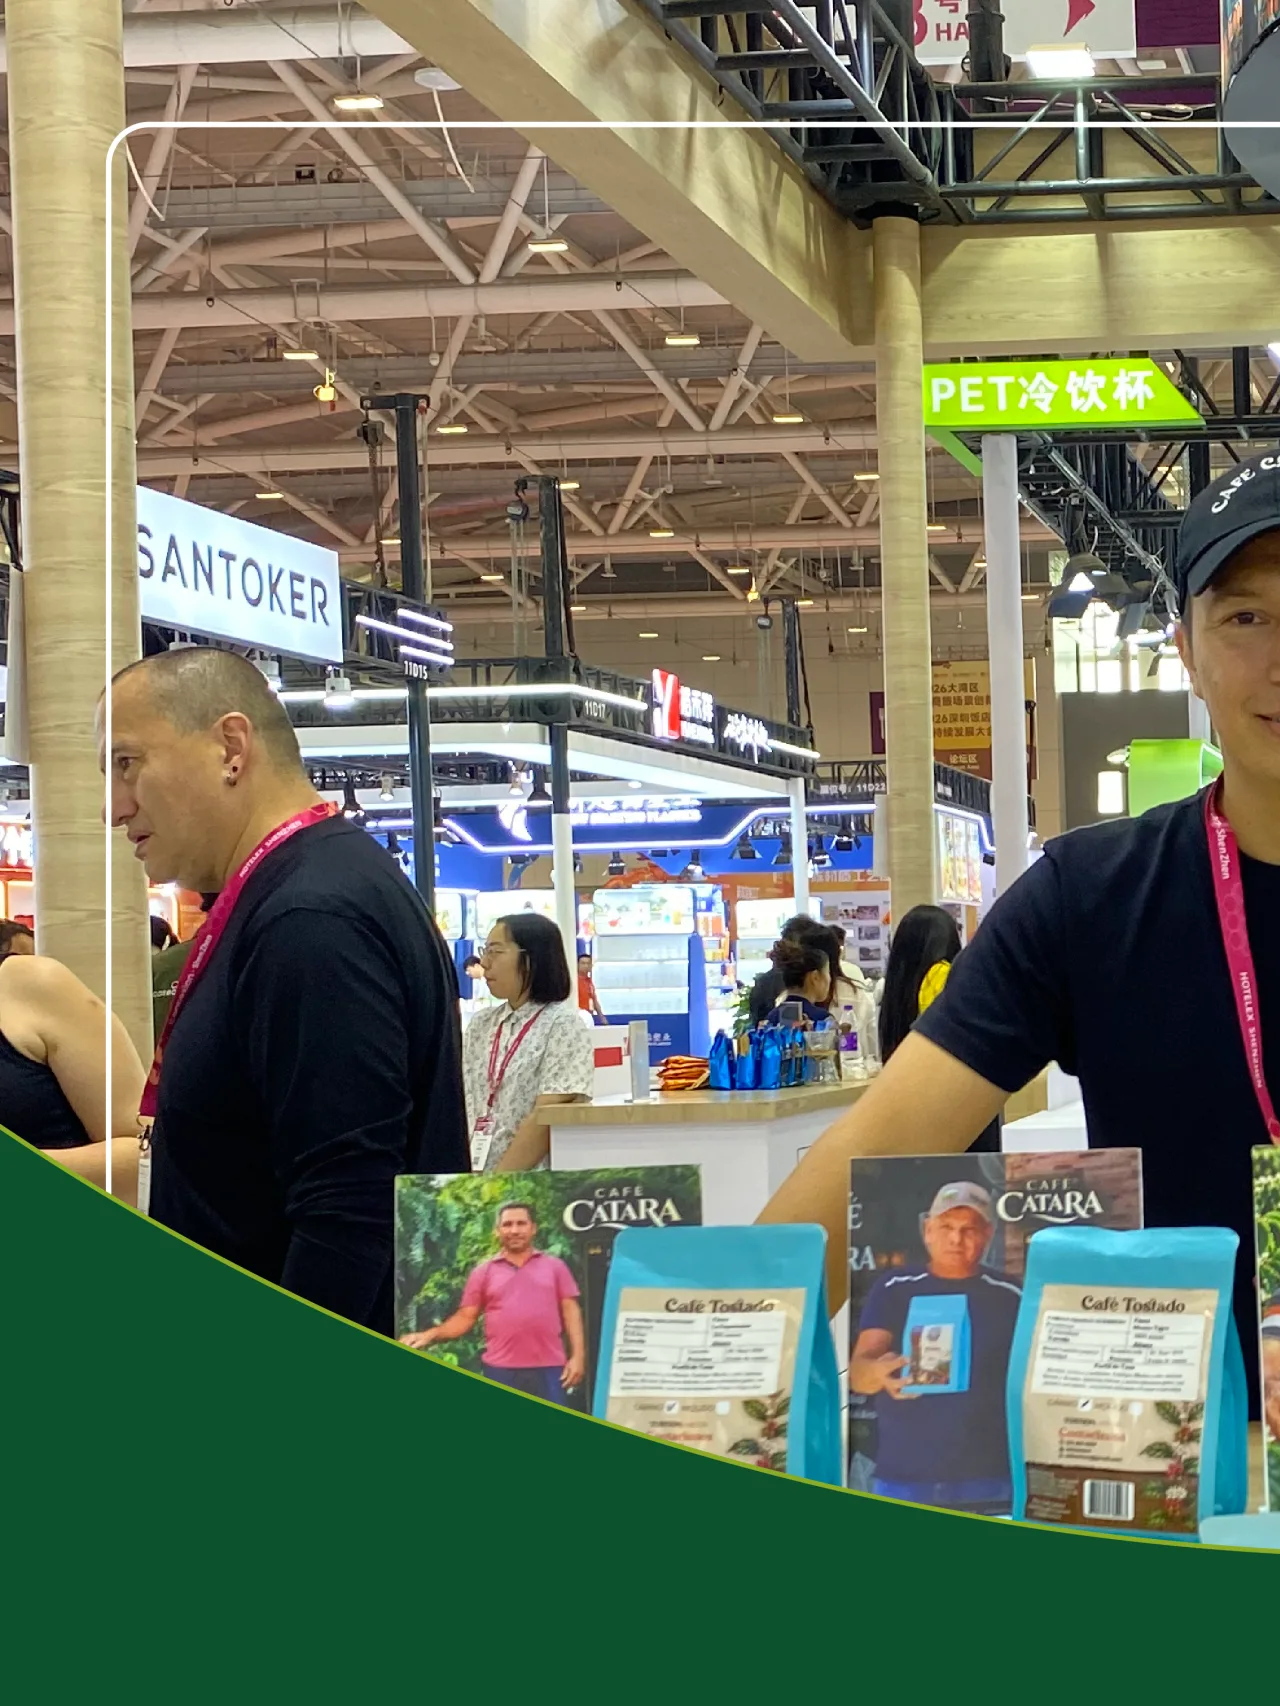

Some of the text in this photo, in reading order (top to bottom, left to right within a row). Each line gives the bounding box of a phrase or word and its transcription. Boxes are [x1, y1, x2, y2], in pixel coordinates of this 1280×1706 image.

[930, 368, 1156, 414] PET冷饮杯
[138, 523, 330, 626] SANTOKER
[404, 660, 428, 680] 11D15
[933, 682, 979, 693] 26大湾区
[584, 700, 606, 718] 11D17
[856, 783, 886, 793] 11D22
[1215, 827, 1230, 880] ShenZhen
[1239, 971, 1253, 1022] HOTELEX
[562, 1197, 682, 1231] CATARA
[996, 1190, 1104, 1222] CATARA
[664, 1297, 775, 1314] Café Tostado
[1081, 1295, 1186, 1314] Café Tostado
